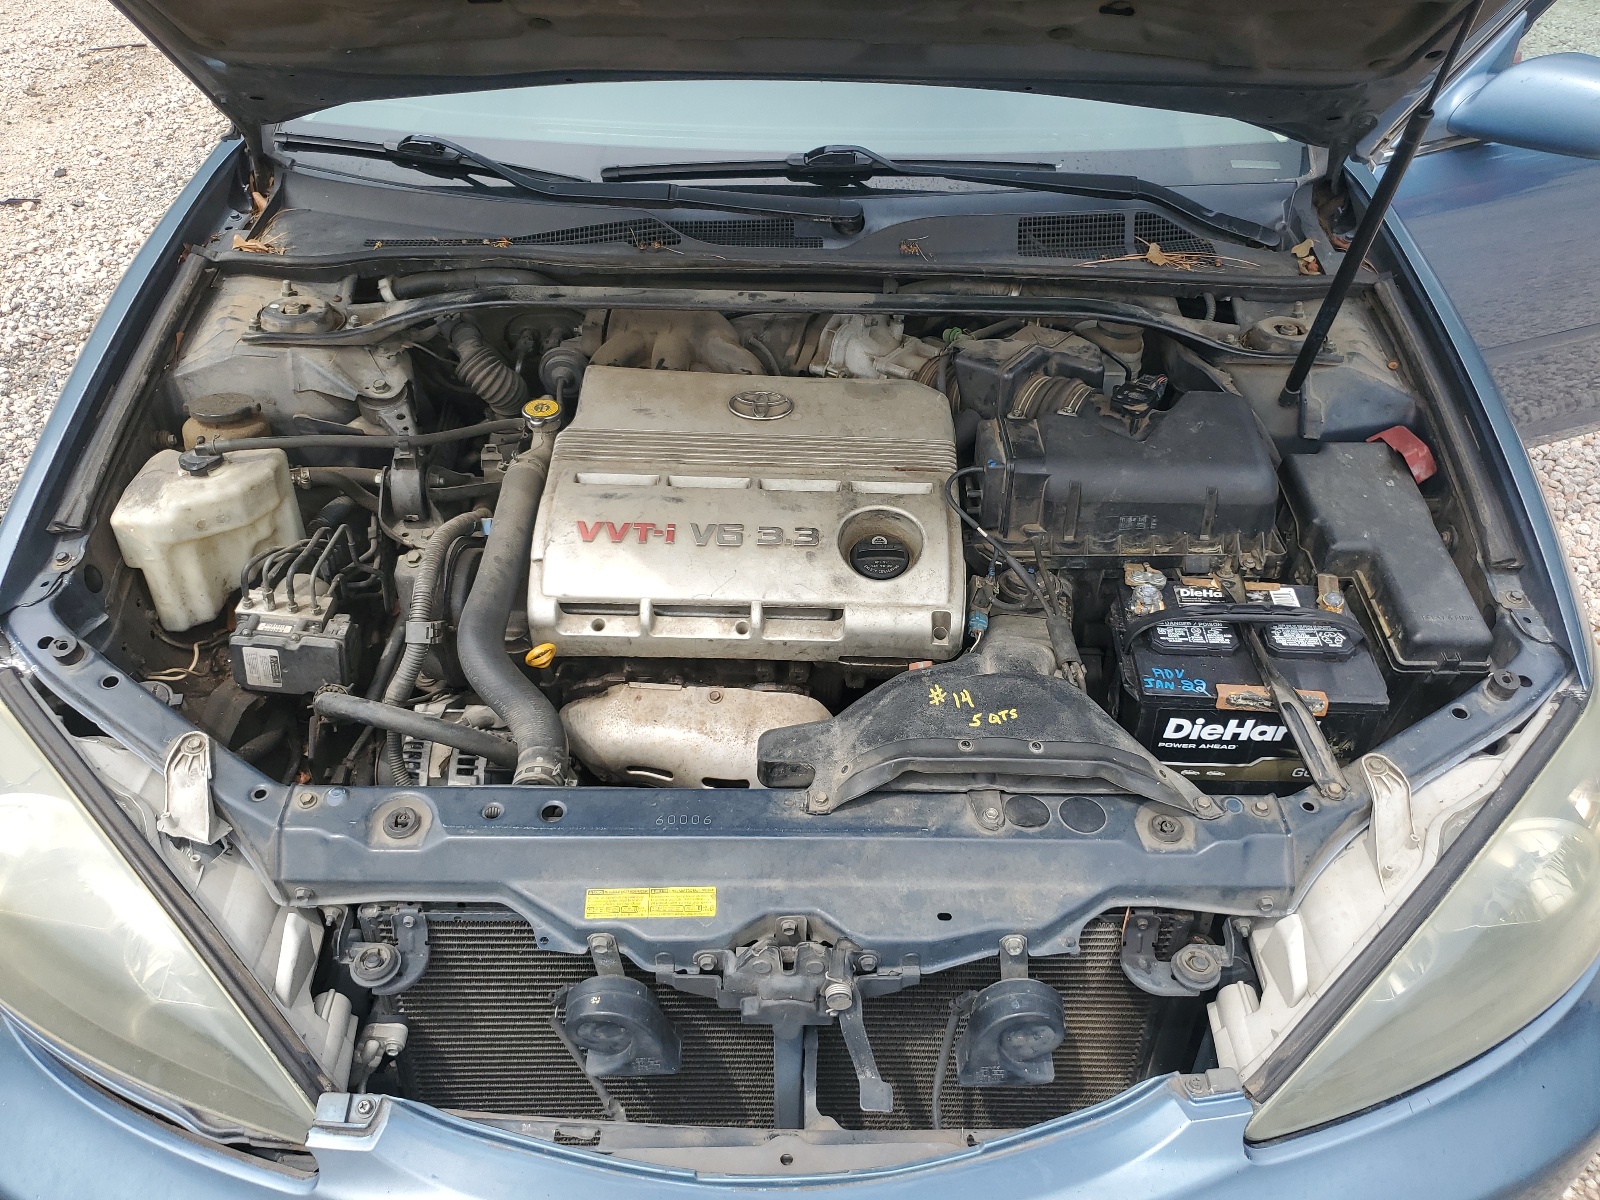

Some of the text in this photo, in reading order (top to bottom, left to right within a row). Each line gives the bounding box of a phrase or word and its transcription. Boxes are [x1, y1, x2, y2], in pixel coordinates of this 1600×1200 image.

[577, 521, 820, 547] VVT-i V6 3.3
[1180, 588, 1224, 598] DieHa
[1151, 667, 1185, 680] ADV
[1162, 717, 1321, 742] DieHar
[655, 814, 712, 825] 60006
